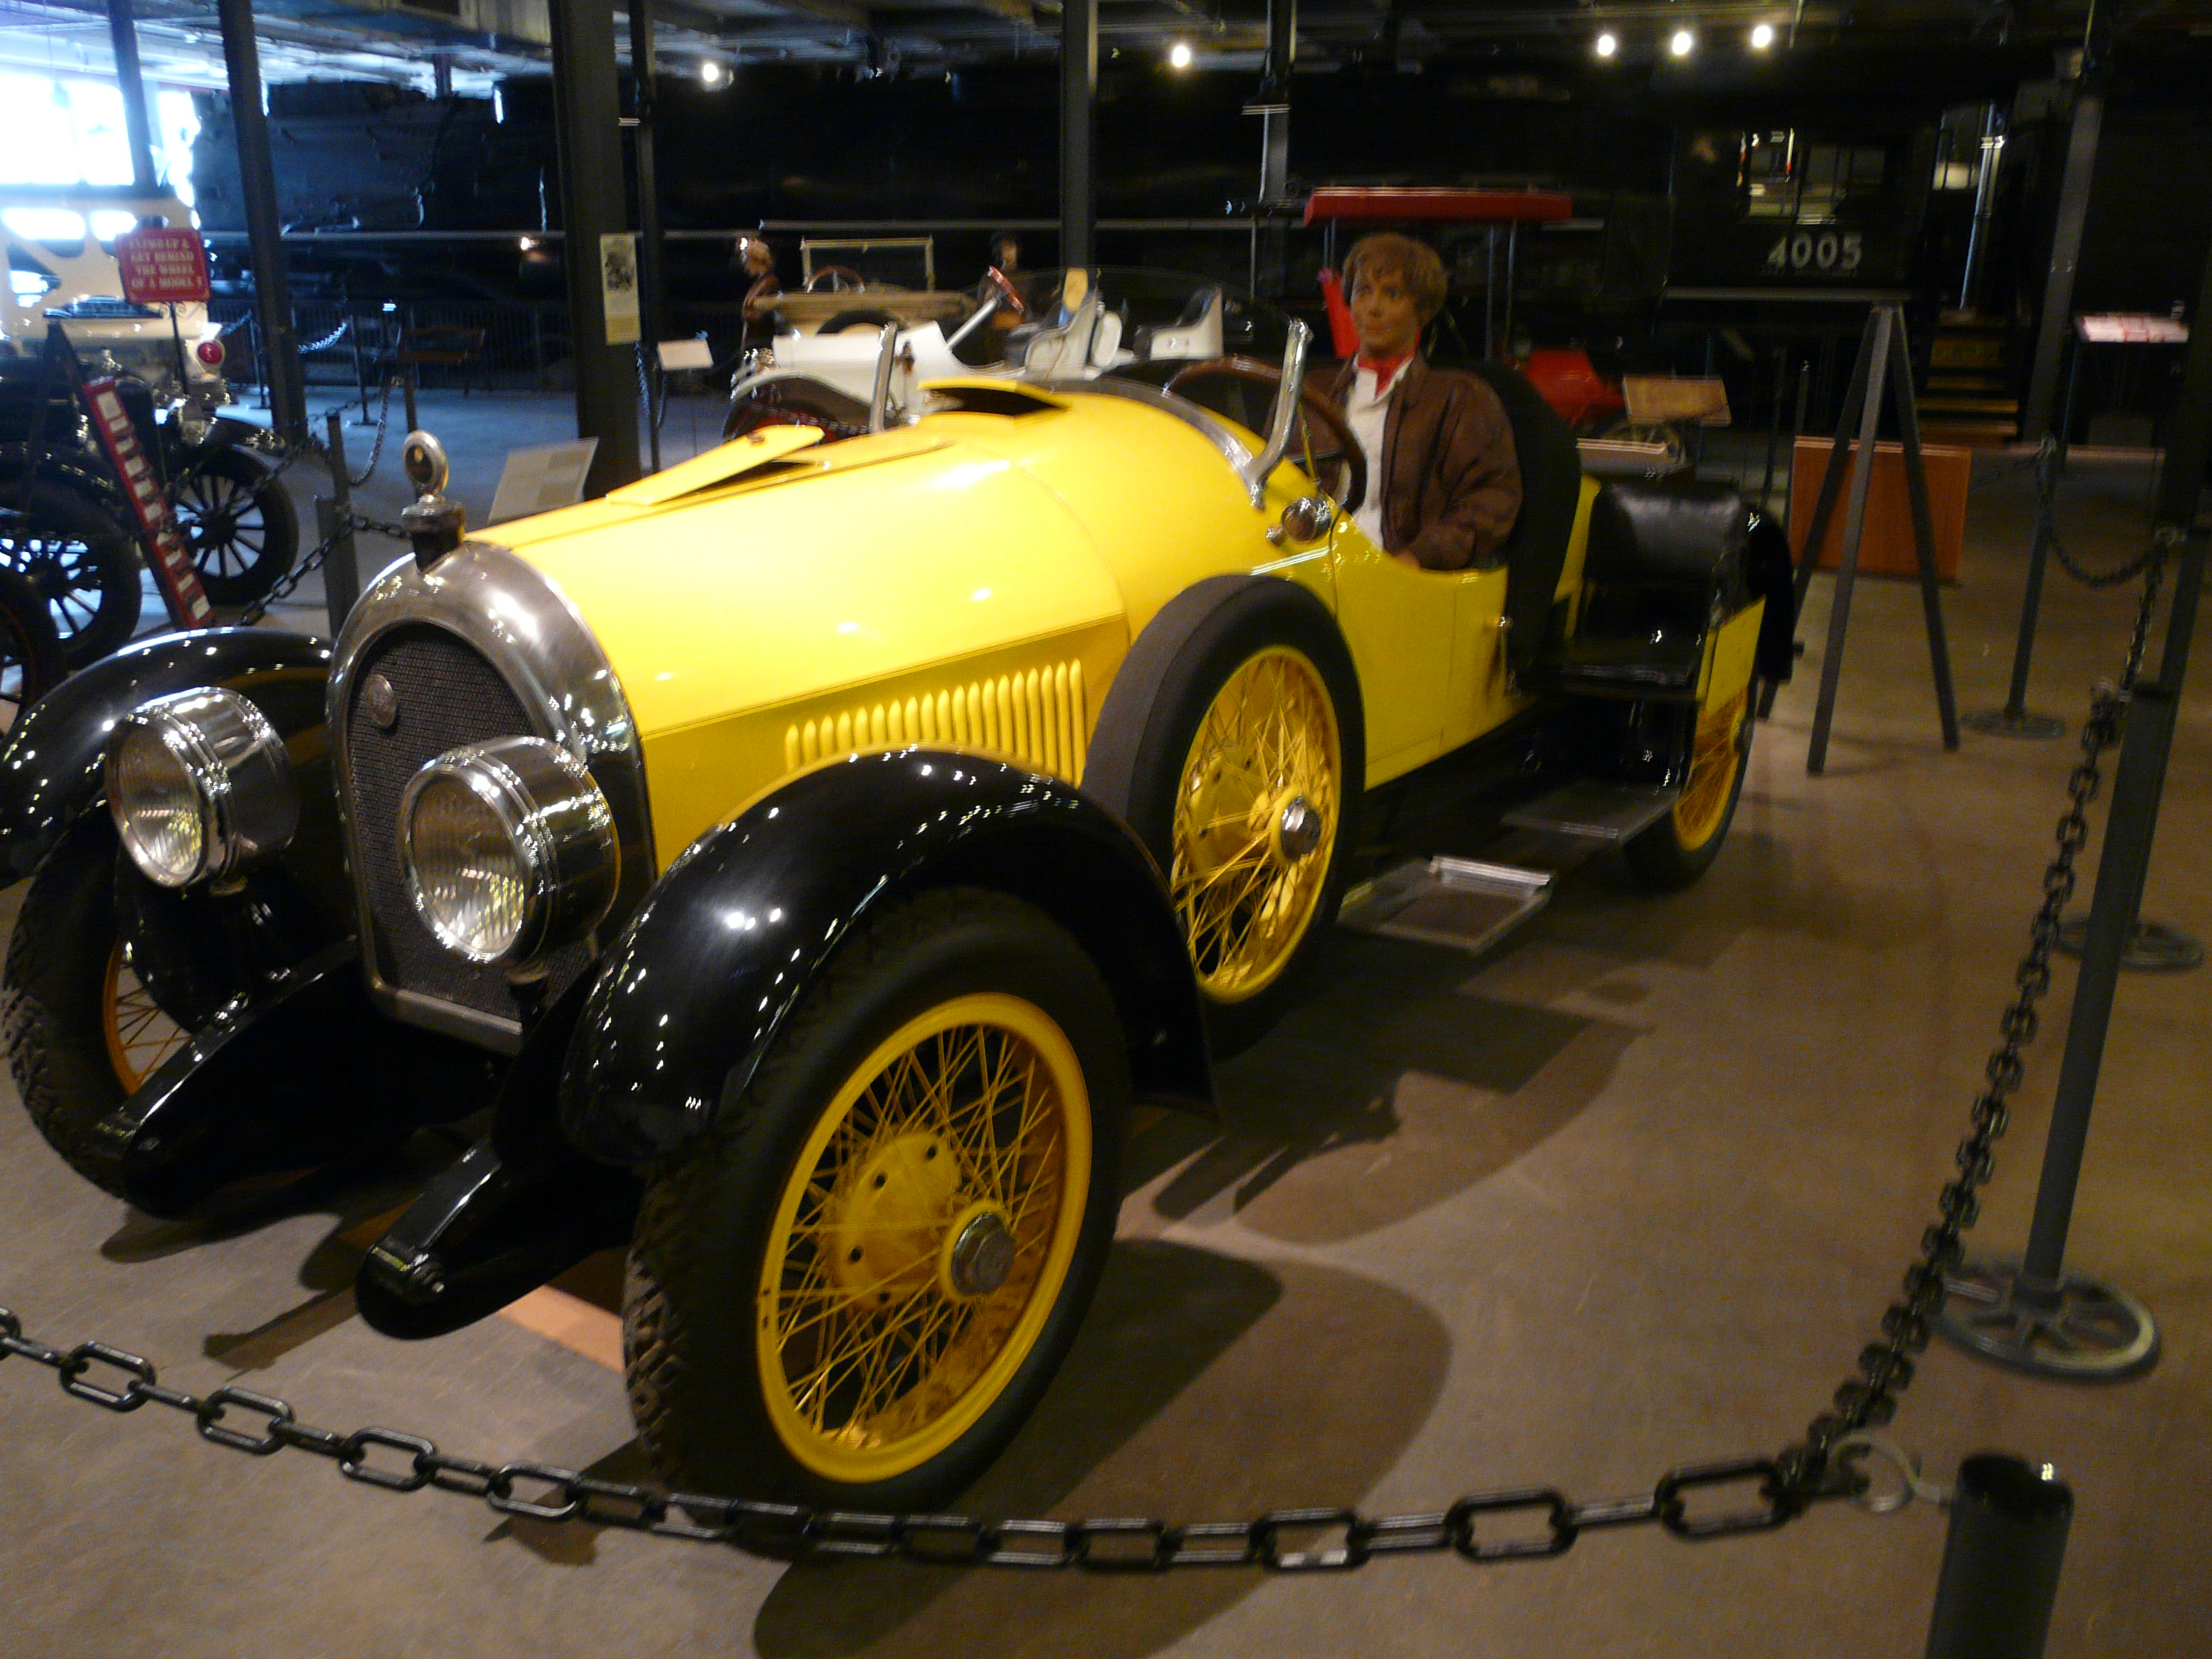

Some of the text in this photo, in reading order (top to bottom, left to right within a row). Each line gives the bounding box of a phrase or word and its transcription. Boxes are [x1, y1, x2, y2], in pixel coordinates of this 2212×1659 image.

[1767, 232, 1862, 269] 4005
[131, 251, 194, 262] GET BEHIND
[136, 264, 194, 274] THE WHEEL
[149, 277, 156, 287] A
[159, 276, 194, 287] MODEL
